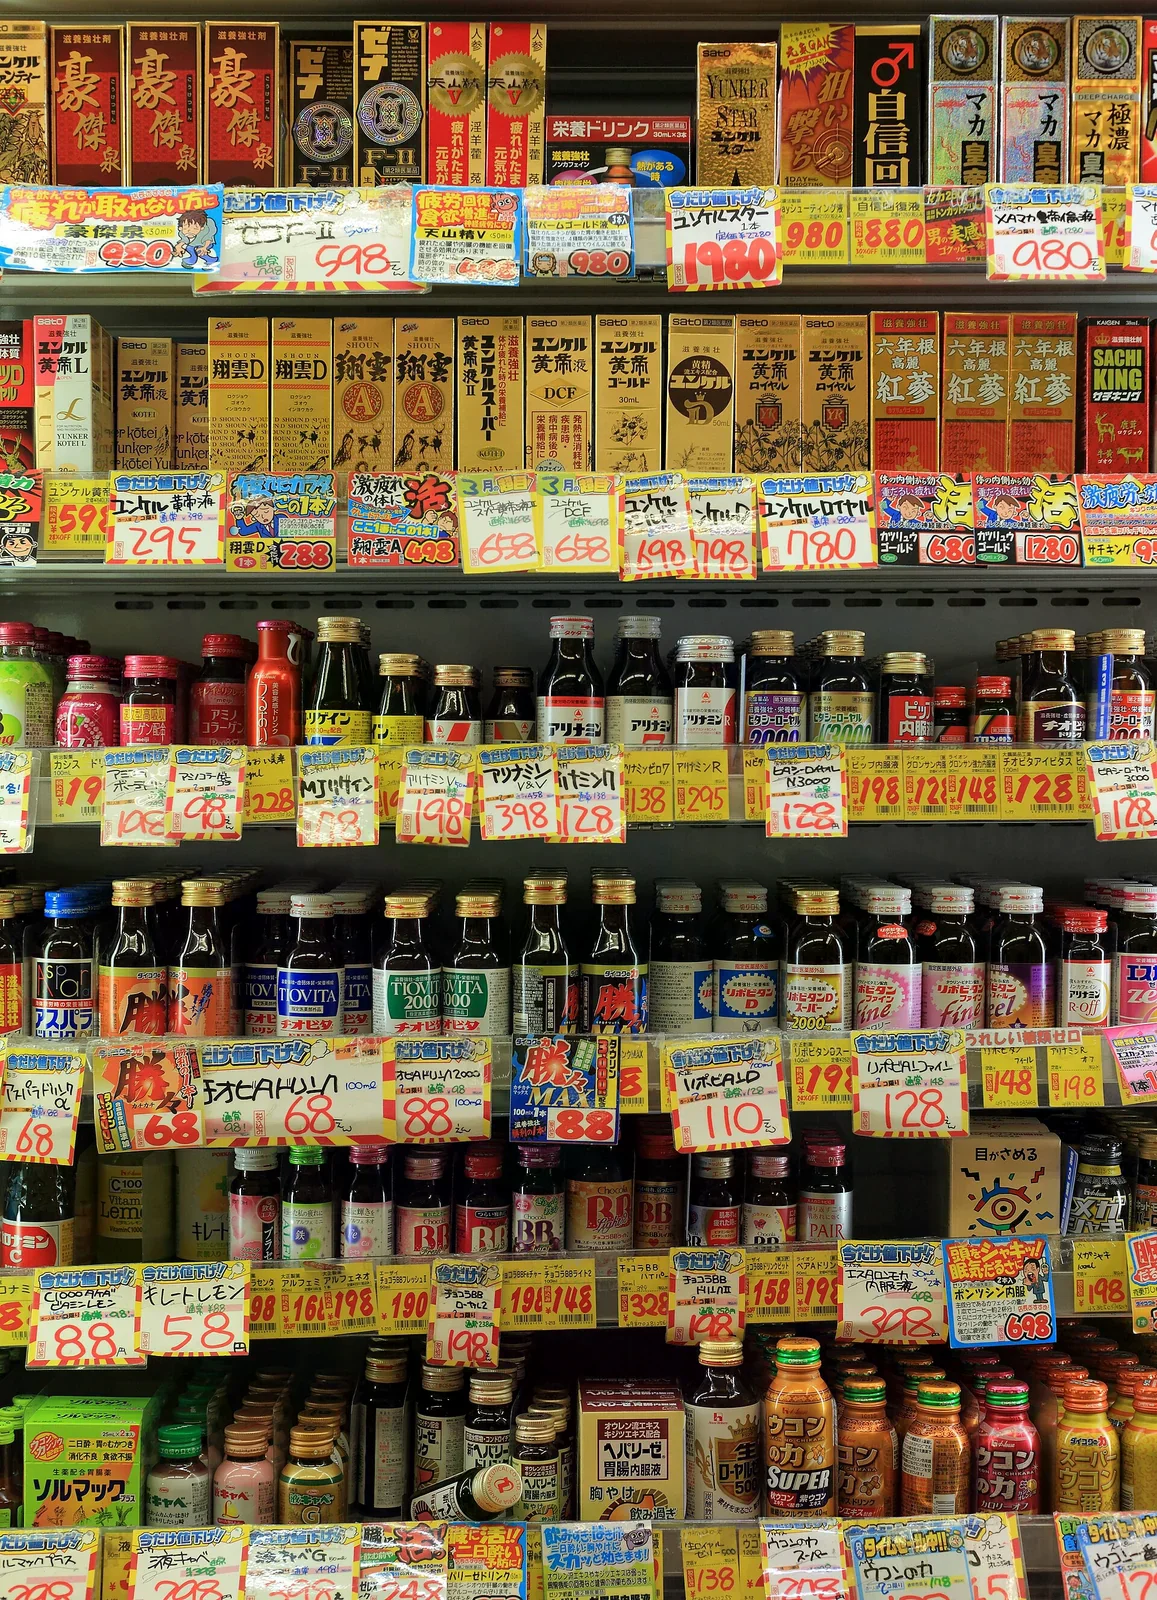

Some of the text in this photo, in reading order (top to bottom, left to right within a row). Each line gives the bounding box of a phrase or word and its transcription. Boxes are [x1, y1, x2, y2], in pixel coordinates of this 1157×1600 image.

[63, 34, 112, 44] 滋養強壮剤
[139, 32, 188, 41] 滋養強壮剤
[703, 49, 730, 57] sato
[297, 48, 327, 99] ゼナ
[707, 75, 768, 99] YUNKER
[716, 106, 757, 128] STAR
[965, 93, 988, 136] マカ
[553, 121, 648, 137] 栄養ドリンク
[711, 131, 761, 142] ユンケル
[1107, 104, 1131, 151] 極濃
[552, 151, 589, 161] 滋養強壮
[718, 144, 754, 155] スター
[637, 162, 673, 171] 熱がある
[418, 192, 490, 209] 疲労回復
[857, 202, 920, 212] 自信回復液
[63, 225, 144, 238] 豪傑泉
[425, 229, 485, 239] 天山精V
[865, 220, 924, 247] 880
[317, 244, 391, 277] 598
[570, 252, 628, 273] 980
[685, 243, 765, 282] 1980
[1013, 240, 1091, 270] 980
[882, 319, 927, 329] 滋養強壮
[38, 341, 87, 354] ユンケル
[875, 337, 935, 356] 六年根
[38, 356, 88, 375] 黄帝L
[335, 350, 391, 382] 翔雲
[508, 336, 519, 381] 滋養強壮
[892, 356, 919, 369] 高麗
[1093, 349, 1141, 367] SACHI
[121, 371, 168, 382] ユンケル
[212, 359, 264, 379] 翔雲D
[276, 359, 328, 379] 翔雲D
[481, 335, 496, 441] ユンケルスーパー
[498, 336, 506, 426] 体が疲れた時の栄養補給に
[608, 378, 650, 388] ゴールド
[816, 382, 855, 391] ロイヤル
[1094, 370, 1141, 391] KING
[121, 384, 168, 402] 黄帝液
[544, 388, 577, 399] DCF
[1093, 392, 1141, 401] サチキング
[536, 415, 545, 458] 栄養補給に
[548, 415, 558, 458] 病中病後の
[573, 415, 582, 470] 発熱性消耗性
[111, 497, 168, 515] ユンケル
[564, 508, 590, 517] DCF
[131, 527, 202, 561] 295
[230, 542, 265, 554] 翔雲D
[405, 541, 454, 562] 498
[479, 534, 536, 563] 658
[556, 535, 610, 562] 658
[788, 529, 855, 562] 780
[880, 542, 914, 553] ゴールド
[1027, 534, 1076, 560] 1280
[1087, 544, 1130, 555] サチキング
[281, 544, 331, 566] 288
[636, 540, 686, 569] 698
[212, 709, 237, 720] アミノ
[683, 715, 722, 726] アリナミン
[202, 722, 244, 733] コラーゲン
[549, 722, 601, 736] アリナミン
[55, 760, 80, 769] カシス
[852, 760, 898, 768] ピップ内服液
[688, 787, 726, 811] 295
[861, 776, 898, 804] 198
[957, 776, 996, 804] 148
[1015, 774, 1072, 804] 128
[252, 791, 294, 811] 228
[416, 799, 463, 834] 198
[497, 802, 548, 832] 398
[564, 804, 613, 835] 128
[784, 802, 835, 830] 128
[278, 988, 336, 1003] TIOVITA
[726, 989, 773, 998] リポビタン
[745, 999, 758, 1008] D
[795, 1004, 822, 1012] スーパー
[1069, 1001, 1099, 1016] R-Off
[281, 1019, 332, 1032] チオビタ
[966, 1031, 1081, 1045] うれしい糖類ゼロ
[1064, 1076, 1096, 1097] 198
[285, 1094, 334, 1134] 68
[403, 1097, 452, 1136] 88
[885, 1090, 945, 1128] 128
[144, 1114, 200, 1146] 68
[556, 1110, 613, 1141] 88
[707, 1103, 763, 1139] 110
[16, 1118, 52, 1155] 68
[976, 1148, 1037, 1161] 目がさめる
[518, 1218, 554, 1243] BB
[811, 1224, 842, 1238] PAIR
[144, 1286, 244, 1306] キレートレモン
[335, 1288, 373, 1316] 198
[553, 1285, 592, 1312] 148
[1089, 1278, 1124, 1306] 198
[164, 1313, 234, 1350] 58
[859, 1306, 932, 1337] 398
[1007, 1315, 1051, 1338] 698
[55, 1323, 116, 1359] 88
[448, 1330, 486, 1360] 198
[605, 1422, 660, 1430] オウレン流エキス
[68, 1439, 133, 1449] 二日酔・胃のむかつき
[604, 1444, 664, 1460] ヘパリーゼ
[68, 1452, 133, 1460] 消化不良 食欲不振
[1061, 1448, 1116, 1466] スーパー
[603, 1462, 661, 1477] 胃腸内服液
[767, 1467, 829, 1490] SUPER
[33, 1479, 127, 1501] ソルマック
[631, 1508, 676, 1520] 飲み過ぎ
[981, 1501, 1028, 1511] カロリーオフ
[458, 1546, 520, 1558] 二日酔い
[697, 1569, 734, 1592] 138
